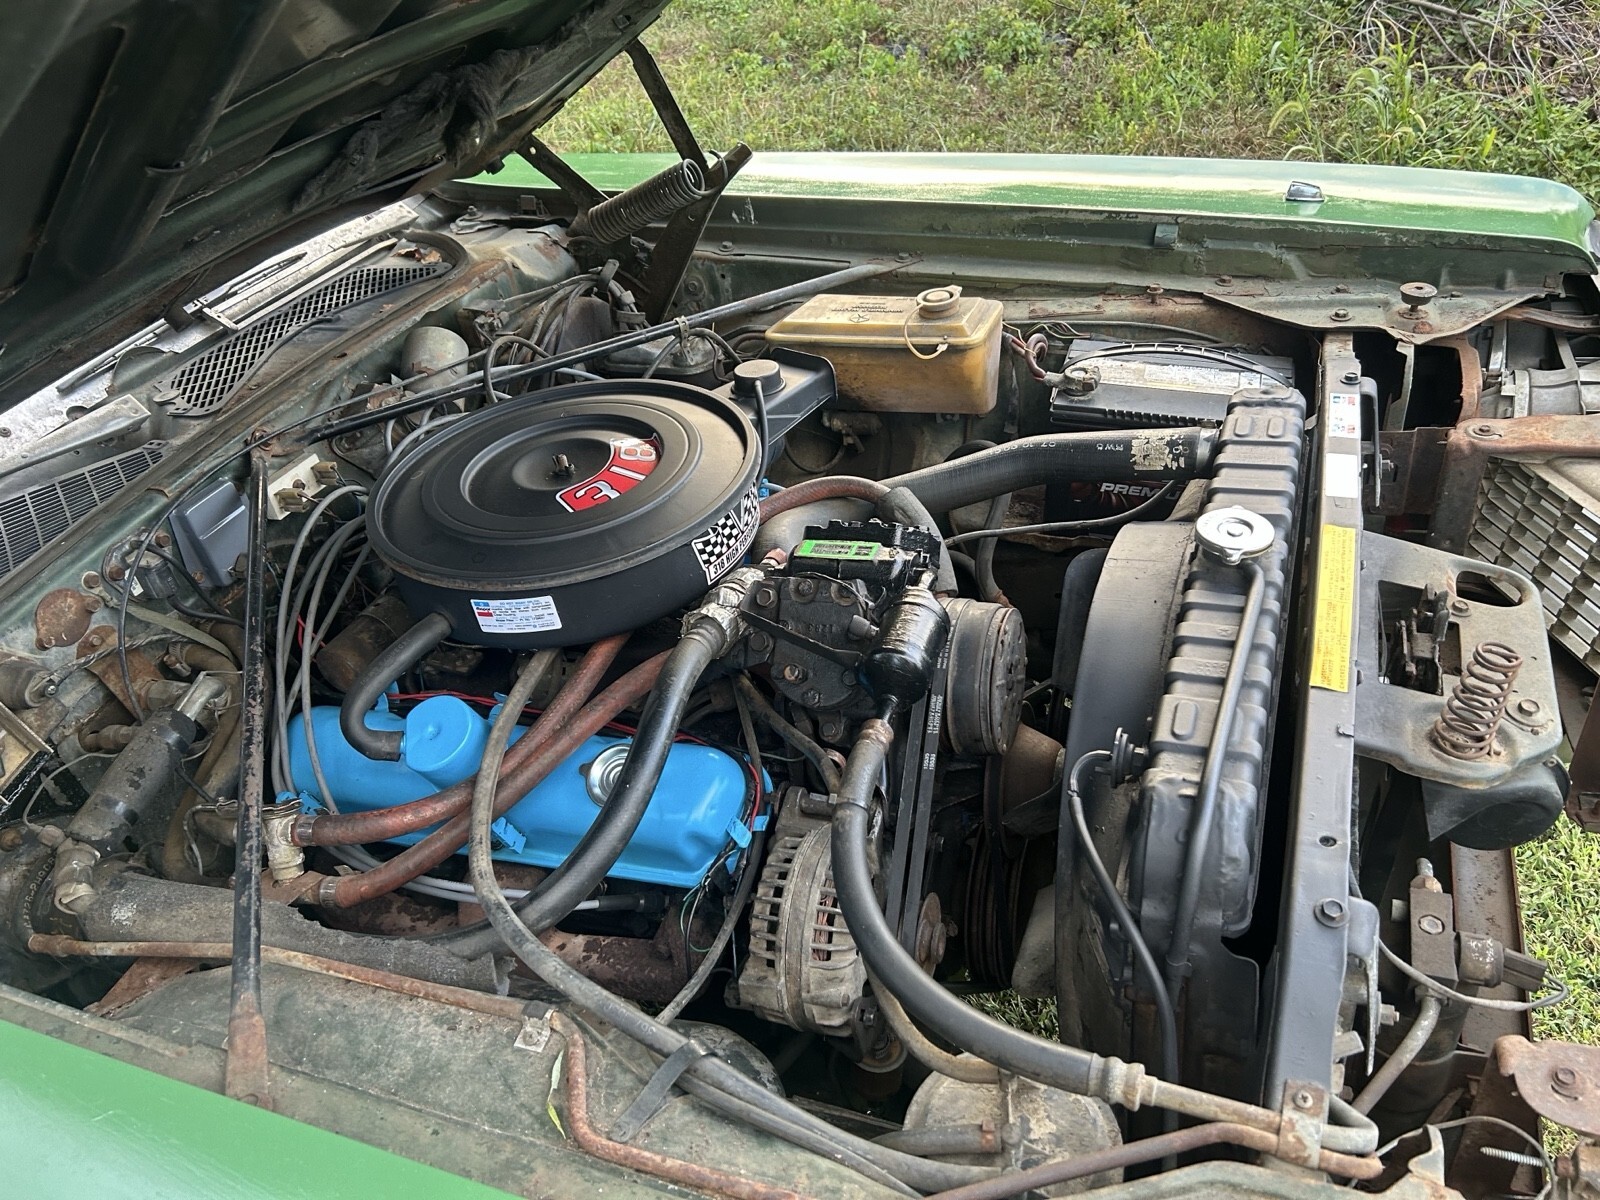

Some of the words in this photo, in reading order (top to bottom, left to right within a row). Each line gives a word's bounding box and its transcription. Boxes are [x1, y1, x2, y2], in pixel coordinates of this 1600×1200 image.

[574, 445, 657, 500] 318
[713, 558, 726, 575] 318
[725, 543, 740, 564] HIGH
